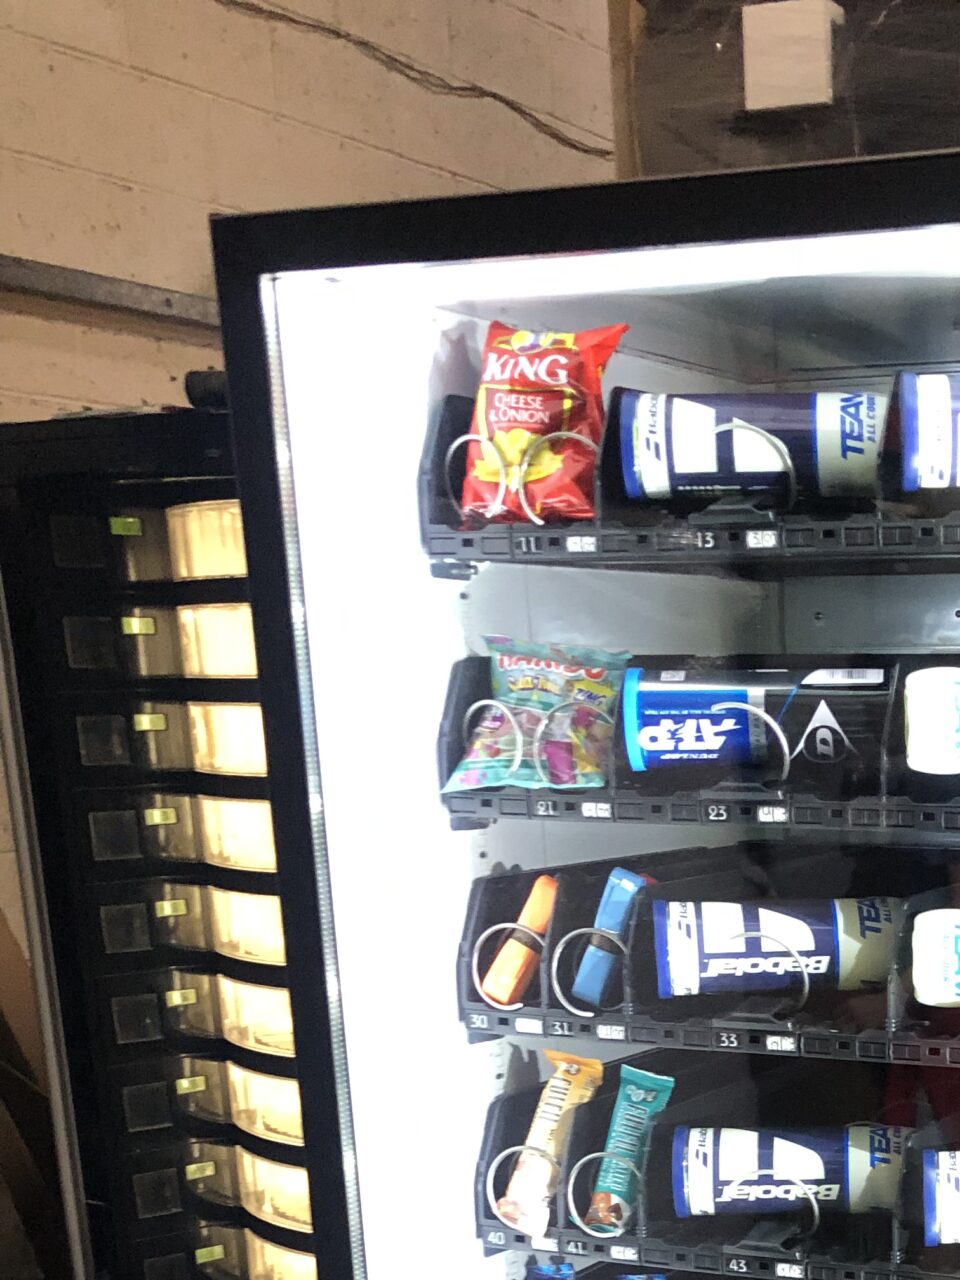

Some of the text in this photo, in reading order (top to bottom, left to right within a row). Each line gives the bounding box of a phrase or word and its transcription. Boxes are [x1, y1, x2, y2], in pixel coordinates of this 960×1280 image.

[483, 352, 569, 385] KING
[494, 392, 544, 410] CHEESE
[499, 406, 550, 424] ONION
[697, 531, 715, 548] 13
[637, 718, 742, 751] ATP
[708, 805, 728, 820] 23
[700, 955, 831, 978] Babolat
[469, 1014, 488, 1028] 30
[552, 1021, 574, 1036] 31
[719, 1033, 738, 1047] 33
[715, 1183, 841, 1203] Babolat
[487, 1231, 506, 1245] 40
[567, 1242, 583, 1254] 41
[728, 1258, 748, 1273] 43
